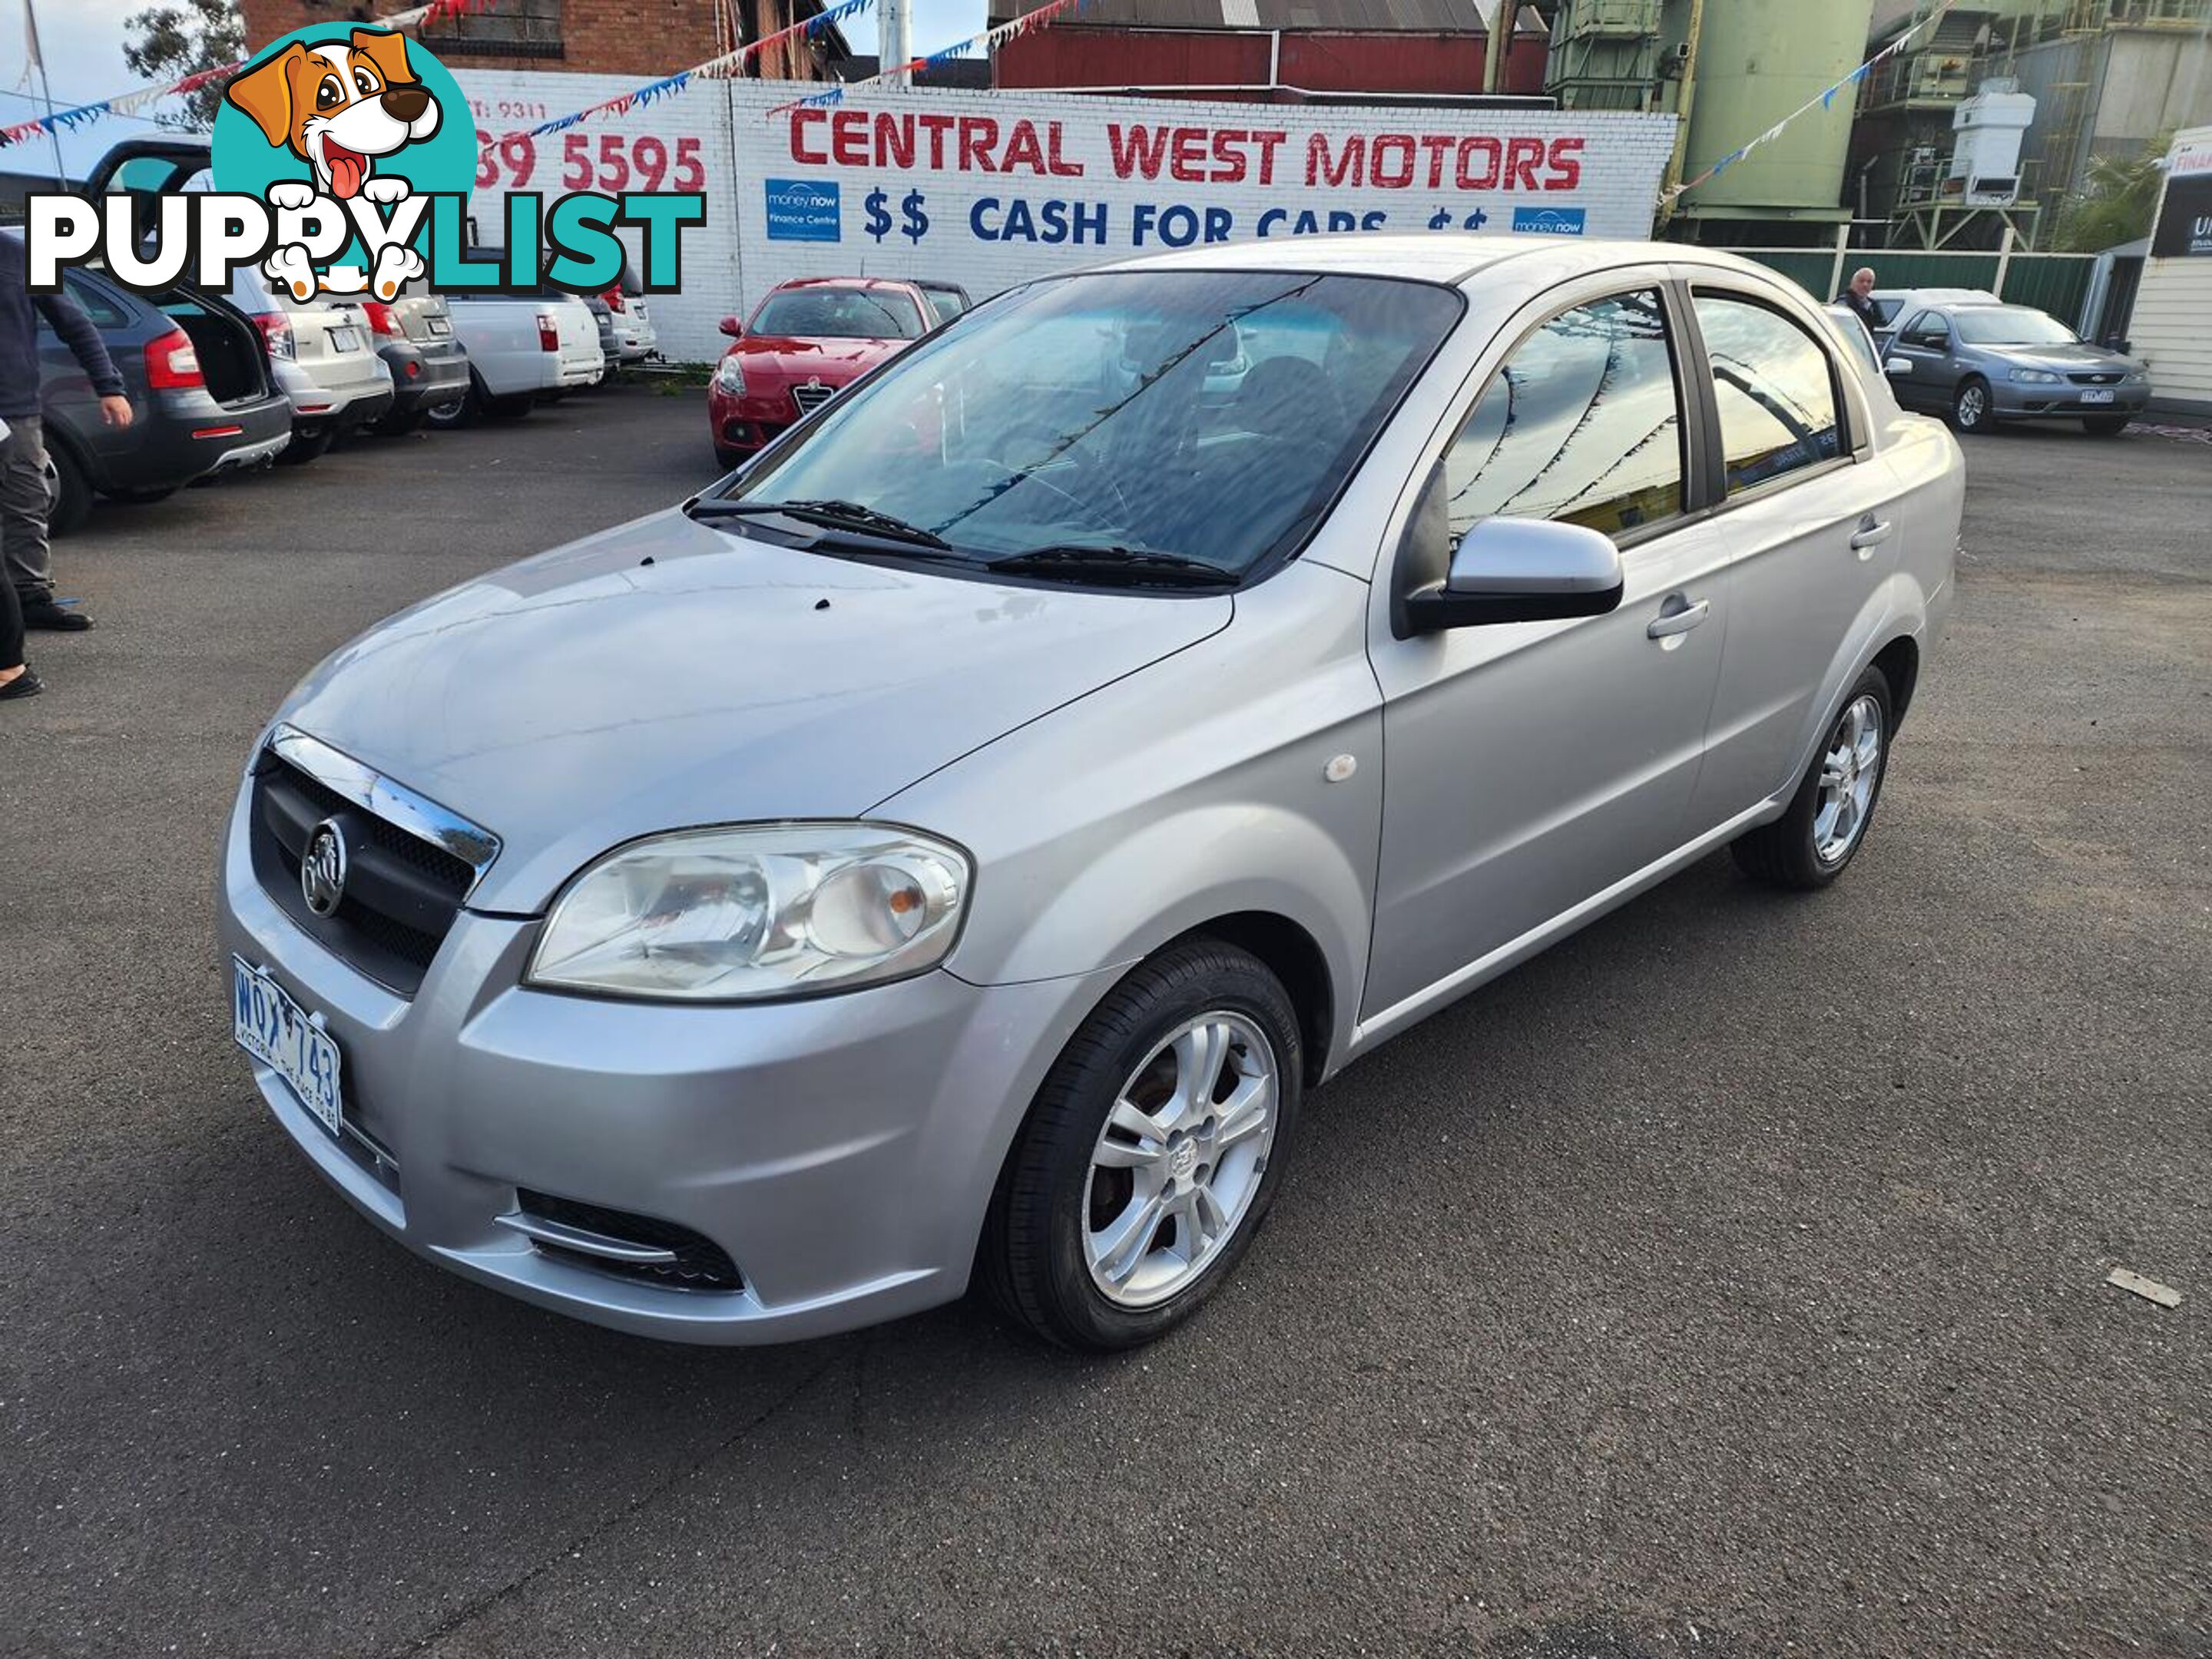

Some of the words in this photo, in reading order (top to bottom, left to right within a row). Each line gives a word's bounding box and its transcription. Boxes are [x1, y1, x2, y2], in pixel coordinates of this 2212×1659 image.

[498, 101, 546, 119] 9311
[563, 133, 705, 193] 5595
[790, 108, 1084, 177] CENTRAL
[1107, 124, 1286, 186] WEST
[1305, 131, 1585, 190] MOTORS
[769, 194, 809, 208] money
[810, 196, 836, 207] now
[770, 214, 804, 224] Finance
[806, 215, 837, 226] Centre
[970, 197, 1107, 244] CASH
[1134, 204, 1233, 247] FOR
[1515, 222, 1554, 233] money
[1555, 223, 1581, 232] now
[295, 1019, 333, 1107] 743
